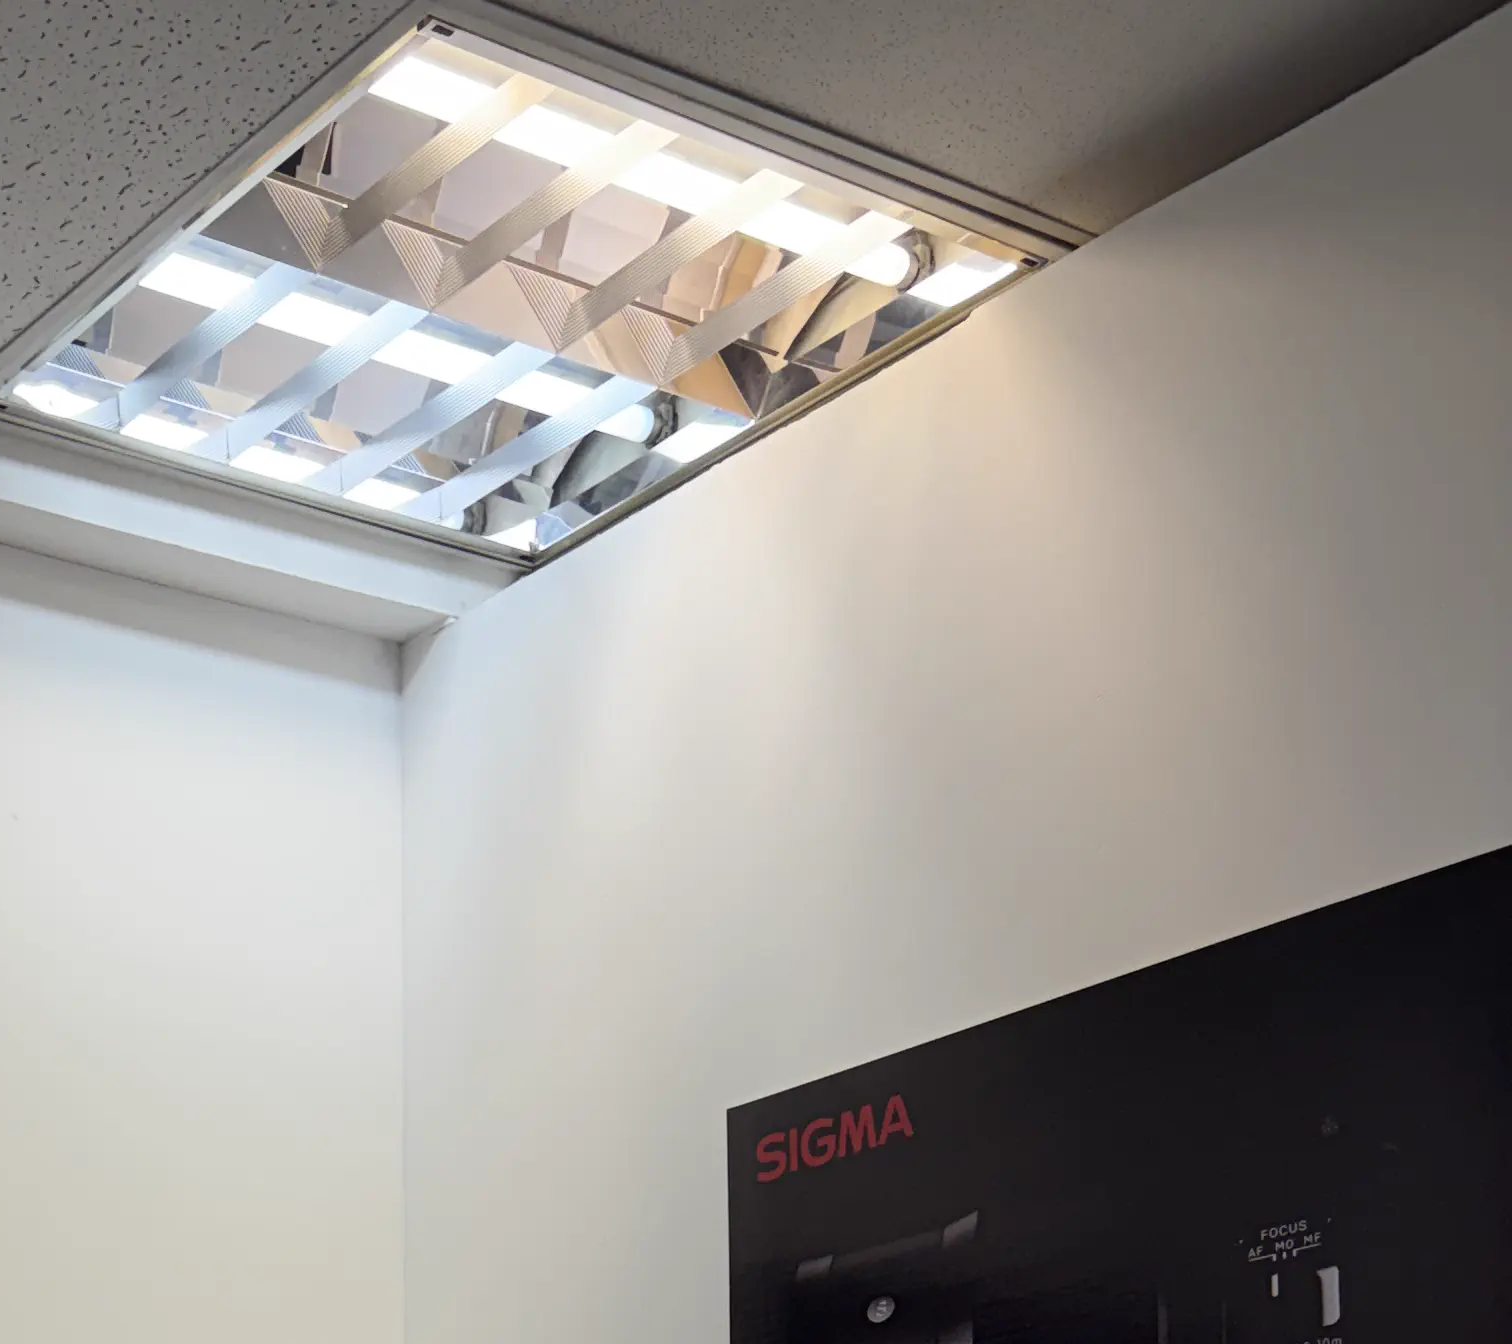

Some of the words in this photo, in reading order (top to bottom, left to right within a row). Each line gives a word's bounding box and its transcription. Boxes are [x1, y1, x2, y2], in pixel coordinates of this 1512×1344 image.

[756, 1094, 914, 1183] SIGMA
[1260, 1220, 1308, 1241] FOCUS
[1248, 1244, 1264, 1258] AF
[1304, 1232, 1321, 1245] MF
